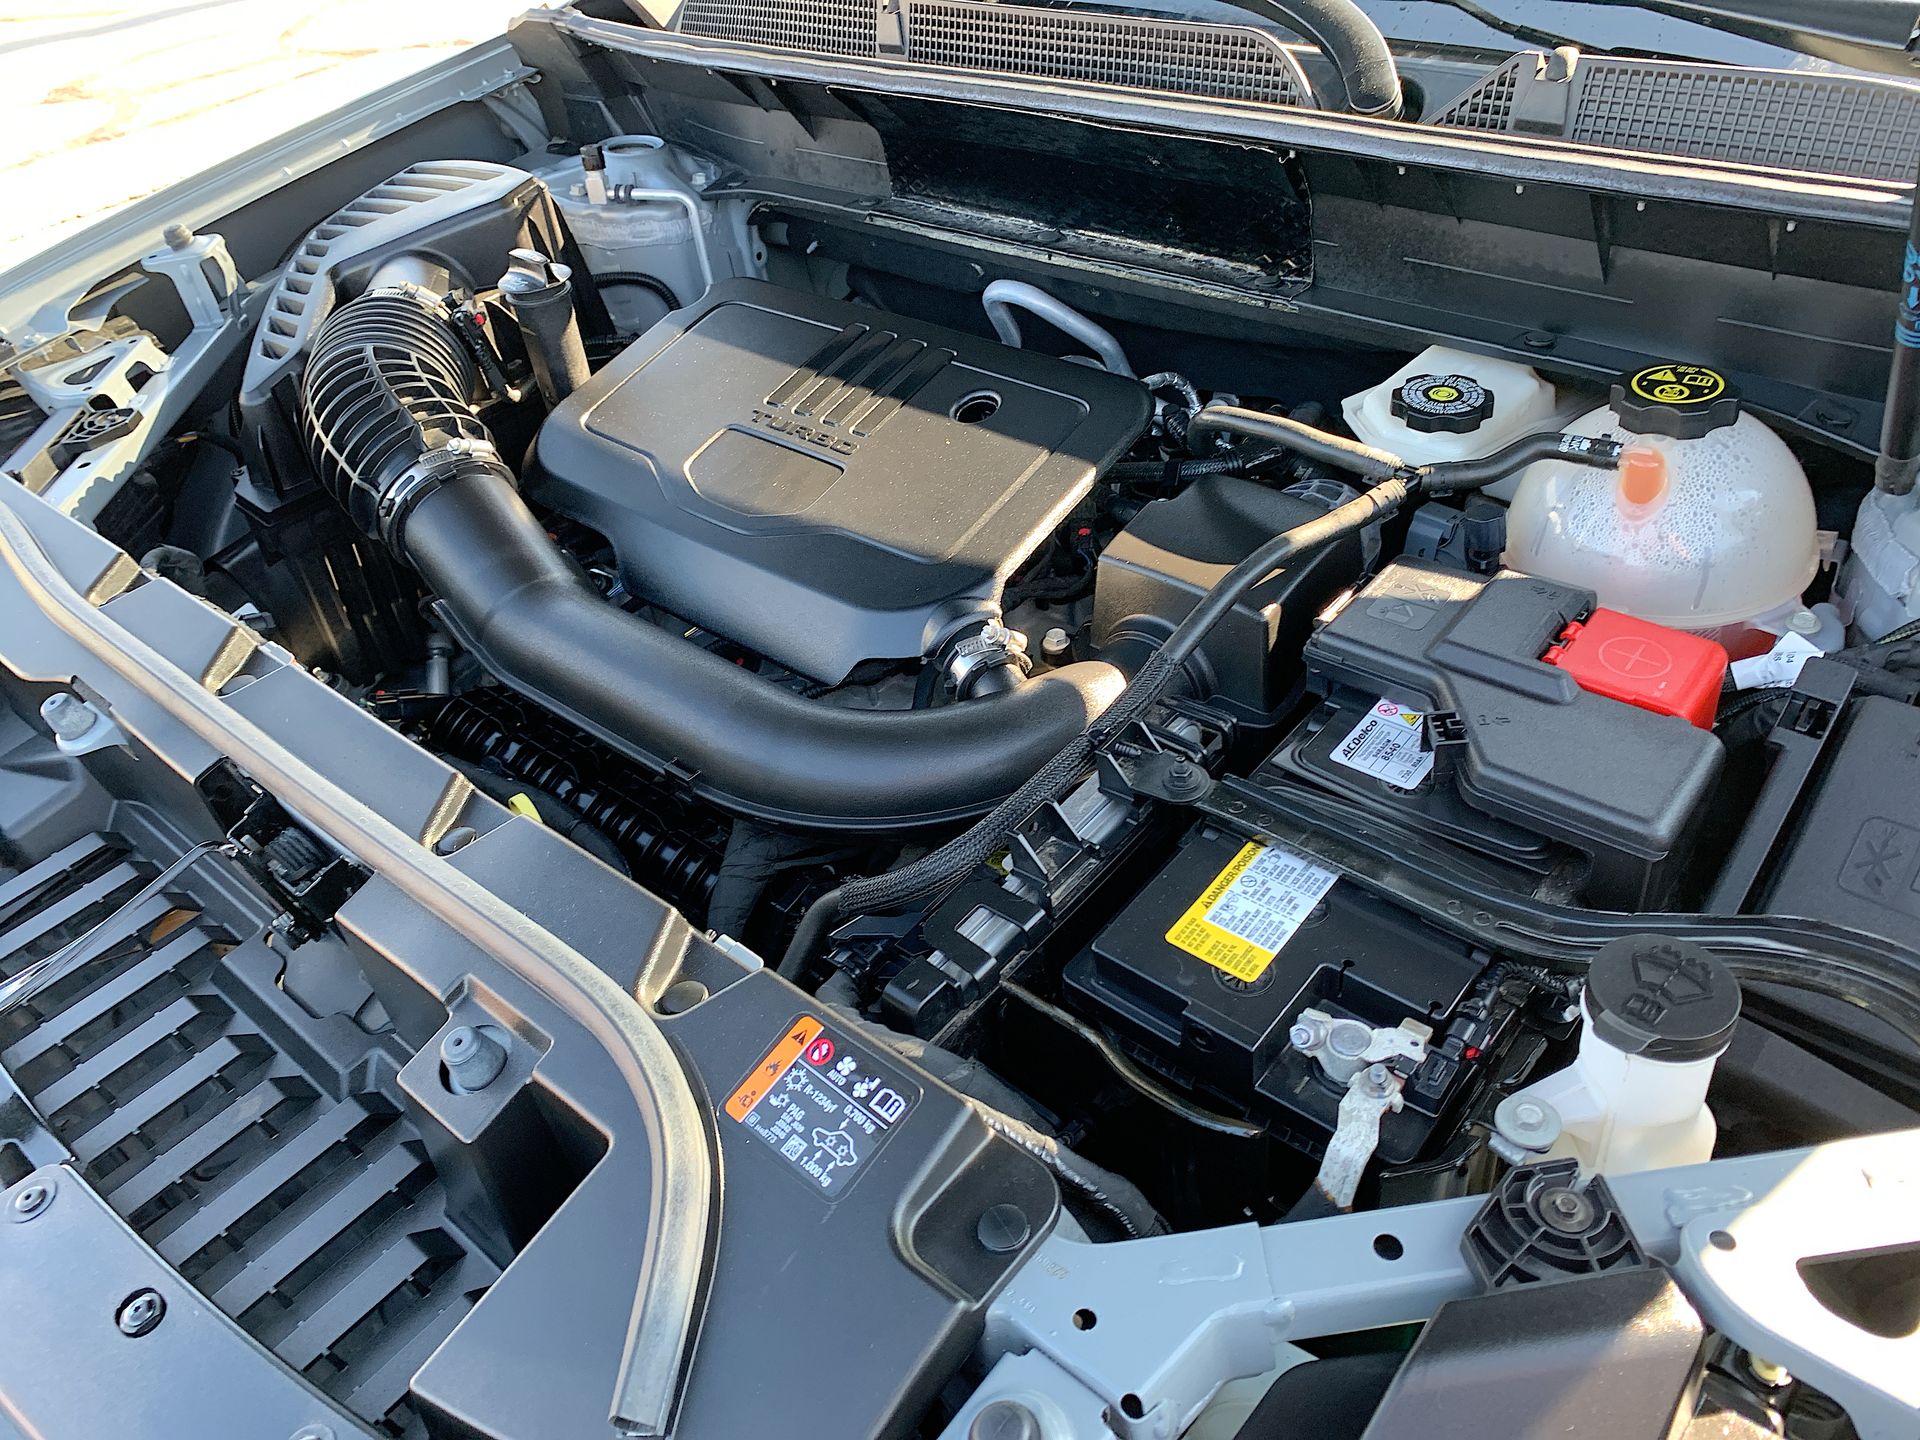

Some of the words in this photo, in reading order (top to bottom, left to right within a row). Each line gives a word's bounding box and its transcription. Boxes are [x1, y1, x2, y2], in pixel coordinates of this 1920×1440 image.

[751, 409, 859, 456] TURBO
[1342, 720, 1378, 758] ACDelco
[1381, 742, 1401, 761] 8540
[1207, 845, 1261, 901] DANGER/POISON
[826, 1069, 847, 1086] AUTO
[786, 1103, 805, 1121] PAG
[803, 1084, 838, 1113] R-1234yf
[843, 1104, 867, 1125] 0.700
[862, 1119, 876, 1135] kg
[800, 1156, 823, 1178] 1.000
[818, 1171, 832, 1188] kg
